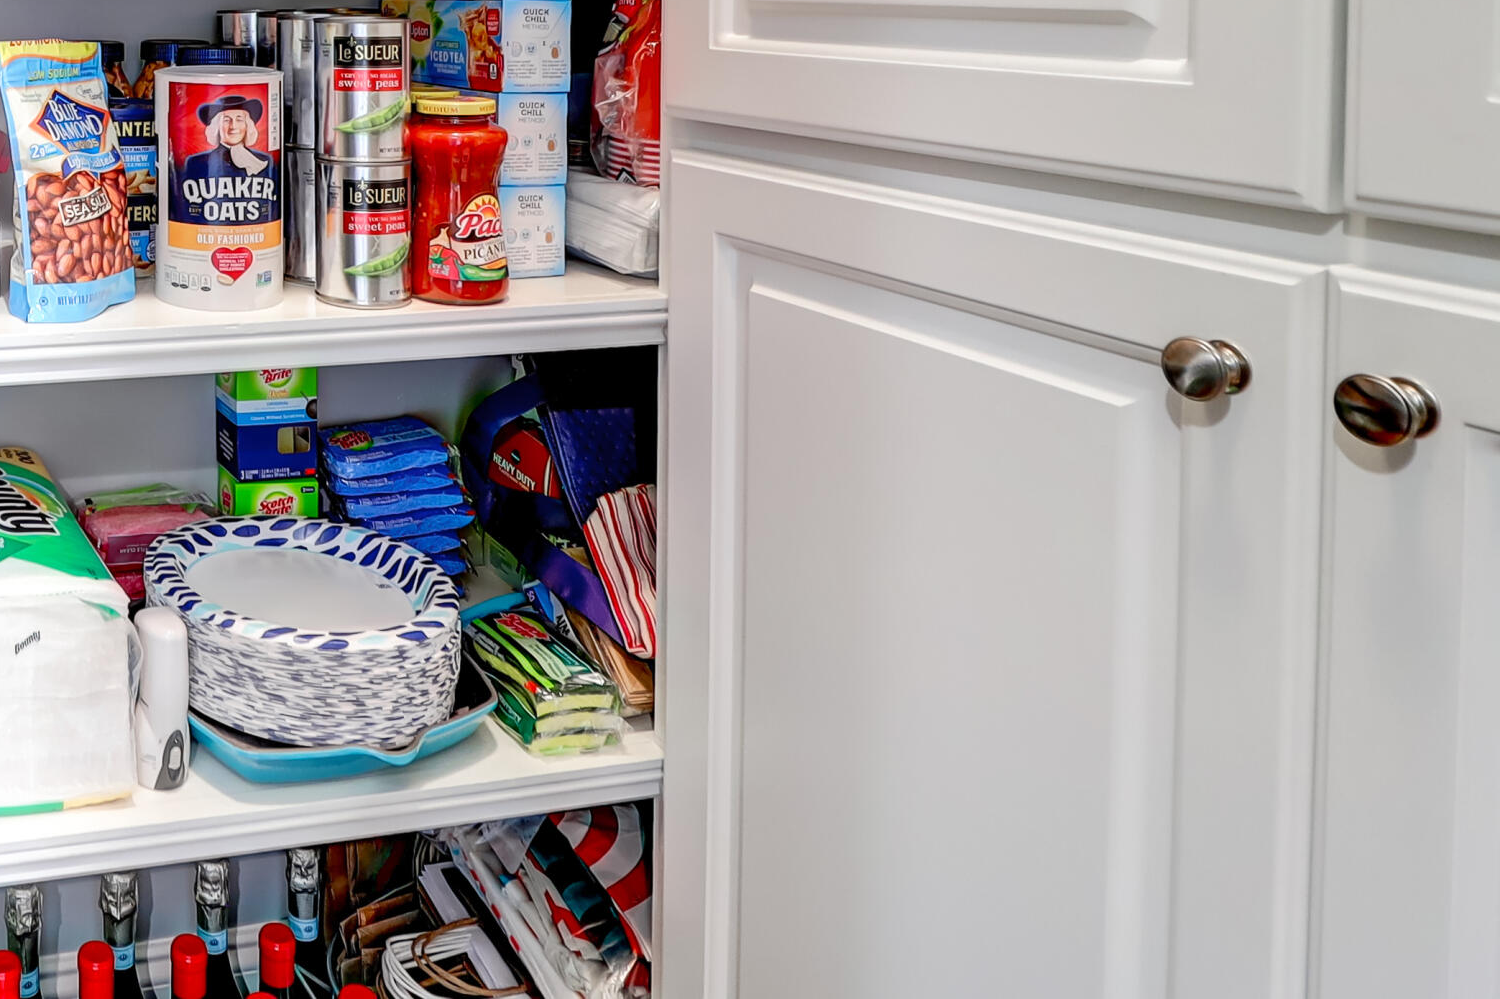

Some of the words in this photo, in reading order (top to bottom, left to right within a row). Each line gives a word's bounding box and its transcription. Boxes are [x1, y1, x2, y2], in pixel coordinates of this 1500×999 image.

[523, 8, 549, 16] QUICK
[525, 15, 547, 23] CHILL
[431, 52, 449, 62] ICED
[450, 52, 465, 62] TEA
[29, 71, 46, 81] LOW
[48, 68, 79, 80] SODIUM
[50, 100, 79, 122] BLUE
[519, 102, 545, 110] QUICK
[46, 115, 102, 142] DIAMOND
[183, 177, 274, 203] QUAKER
[204, 201, 260, 221] OATS
[197, 233, 214, 244] OLD
[217, 233, 265, 244] FASHIONED
